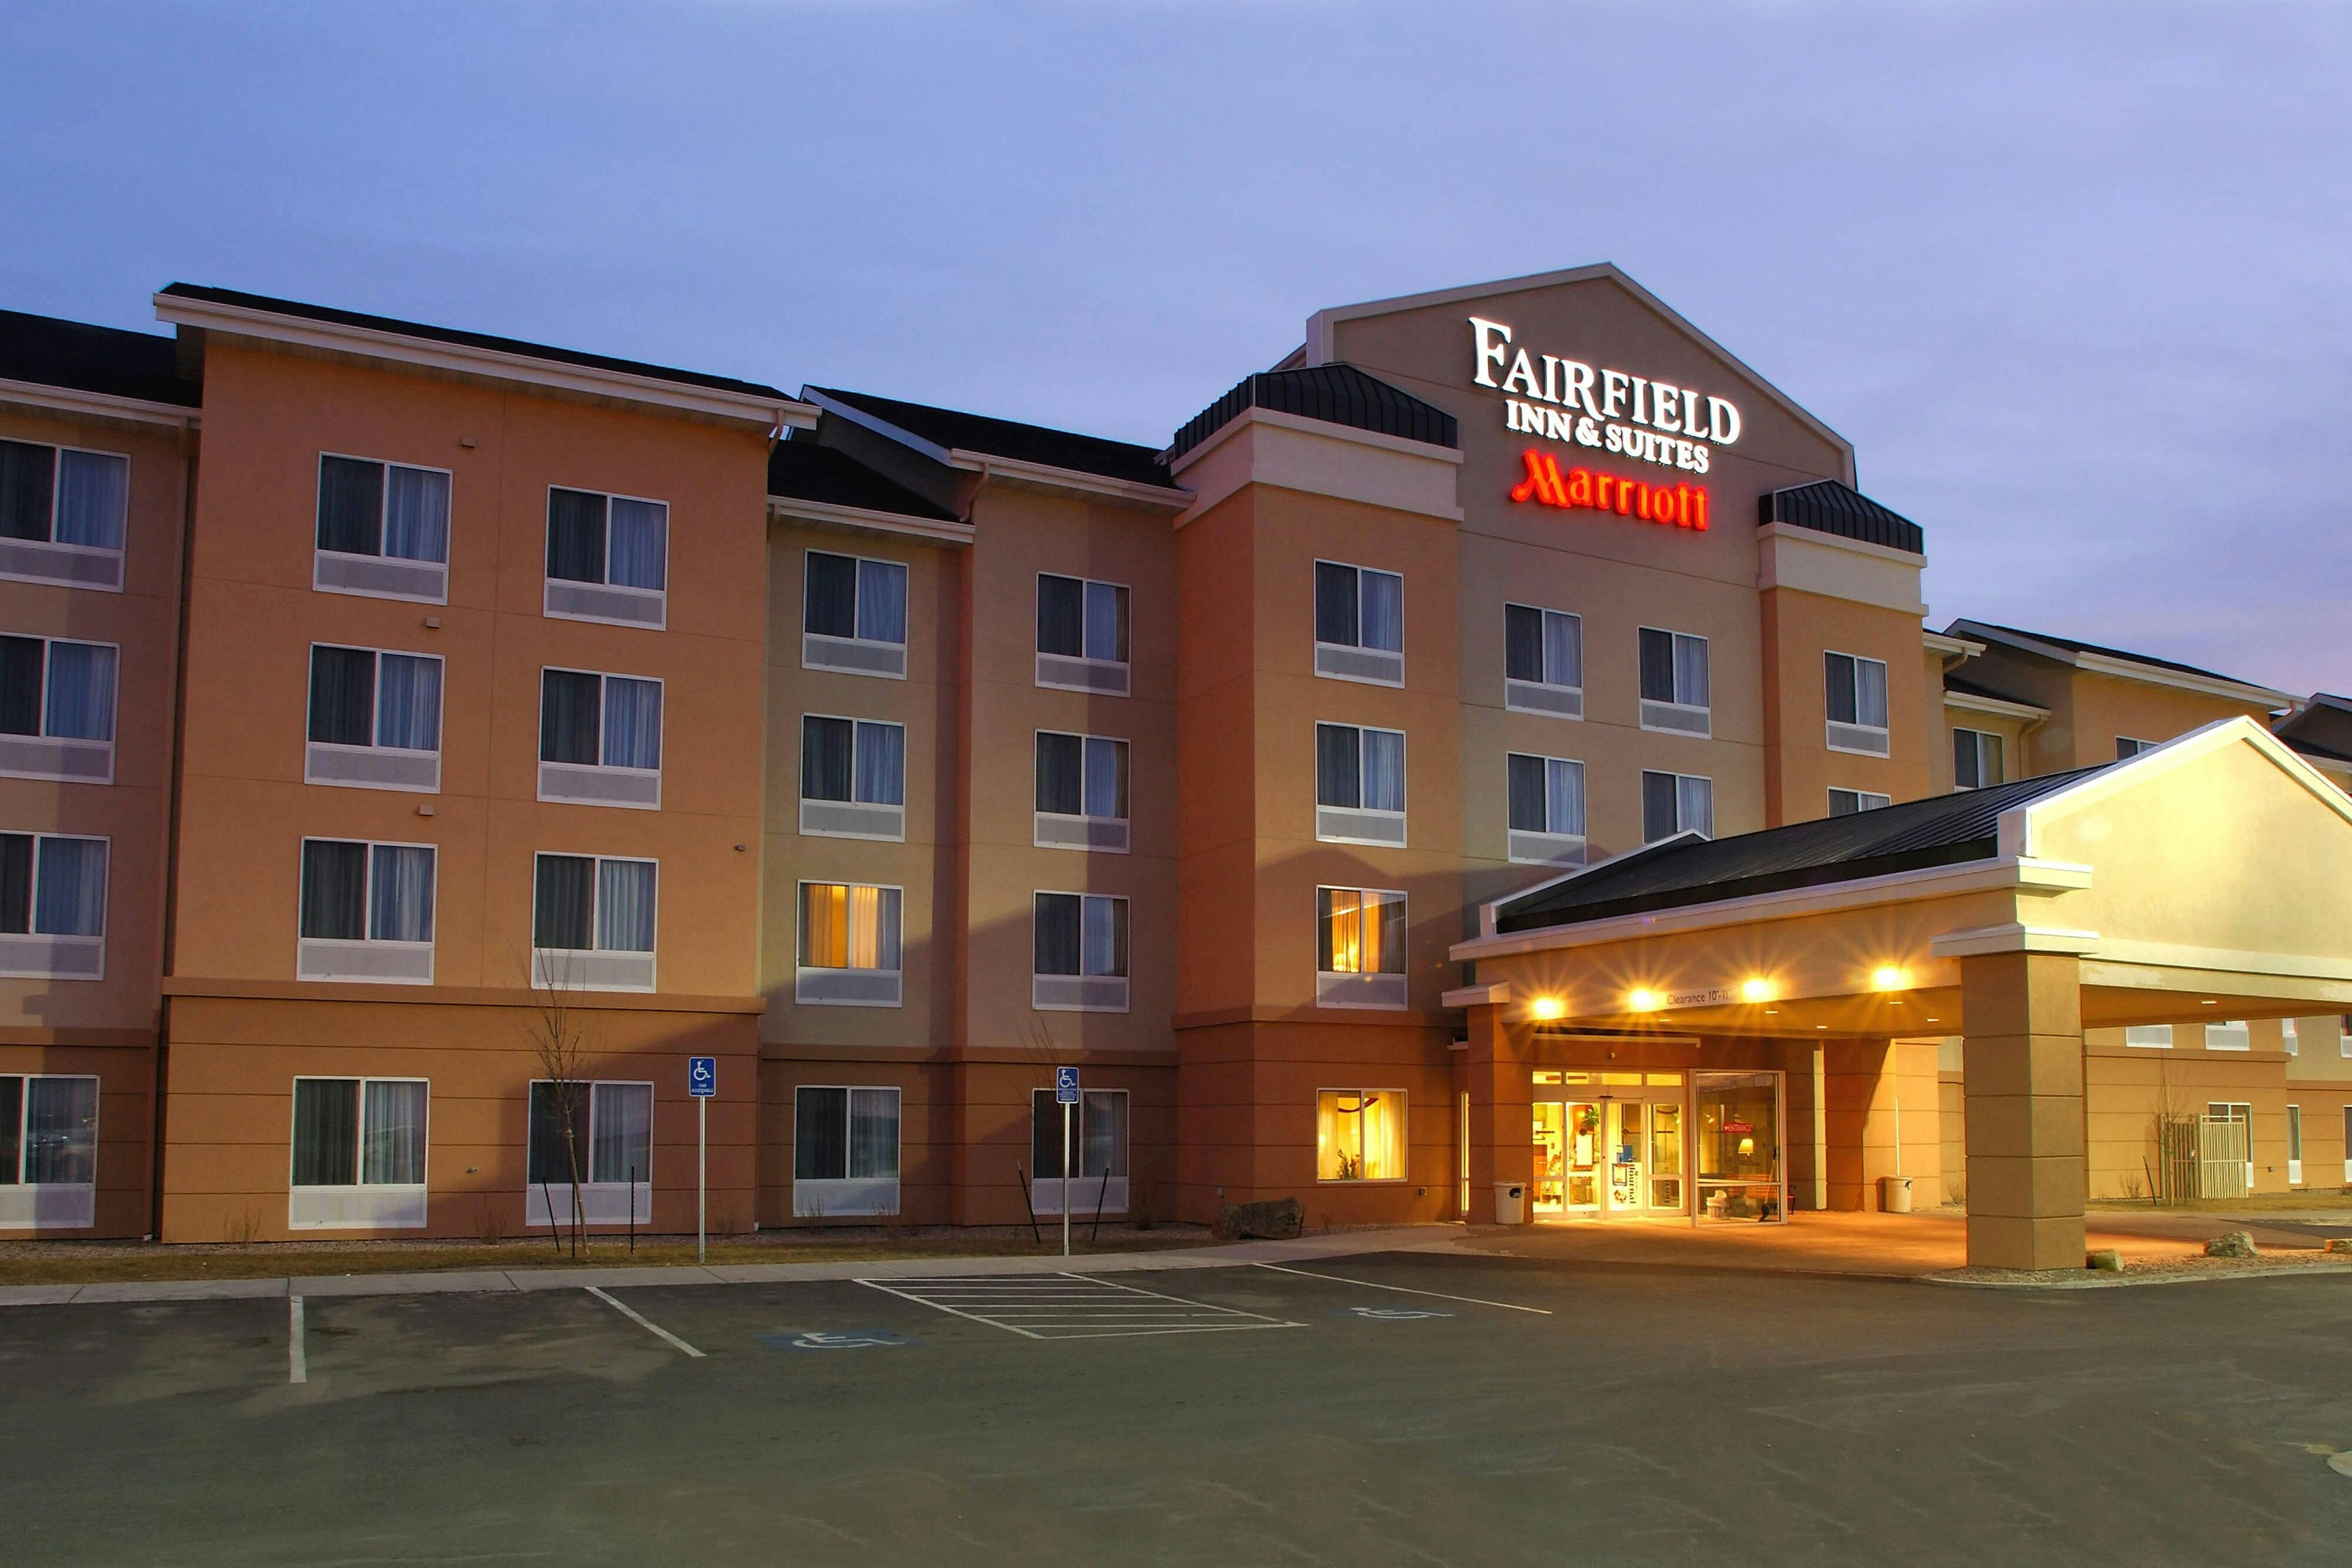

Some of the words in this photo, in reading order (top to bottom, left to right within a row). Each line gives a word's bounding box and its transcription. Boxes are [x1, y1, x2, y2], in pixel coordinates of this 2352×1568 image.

[1469, 317, 1741, 444] FAIRFIELD
[1505, 399, 1572, 443] INN
[1575, 416, 1602, 447] &
[1605, 423, 1709, 474] SUITES
[1510, 449, 1708, 531] Marriott
[1667, 994, 1705, 1005] Clearance
